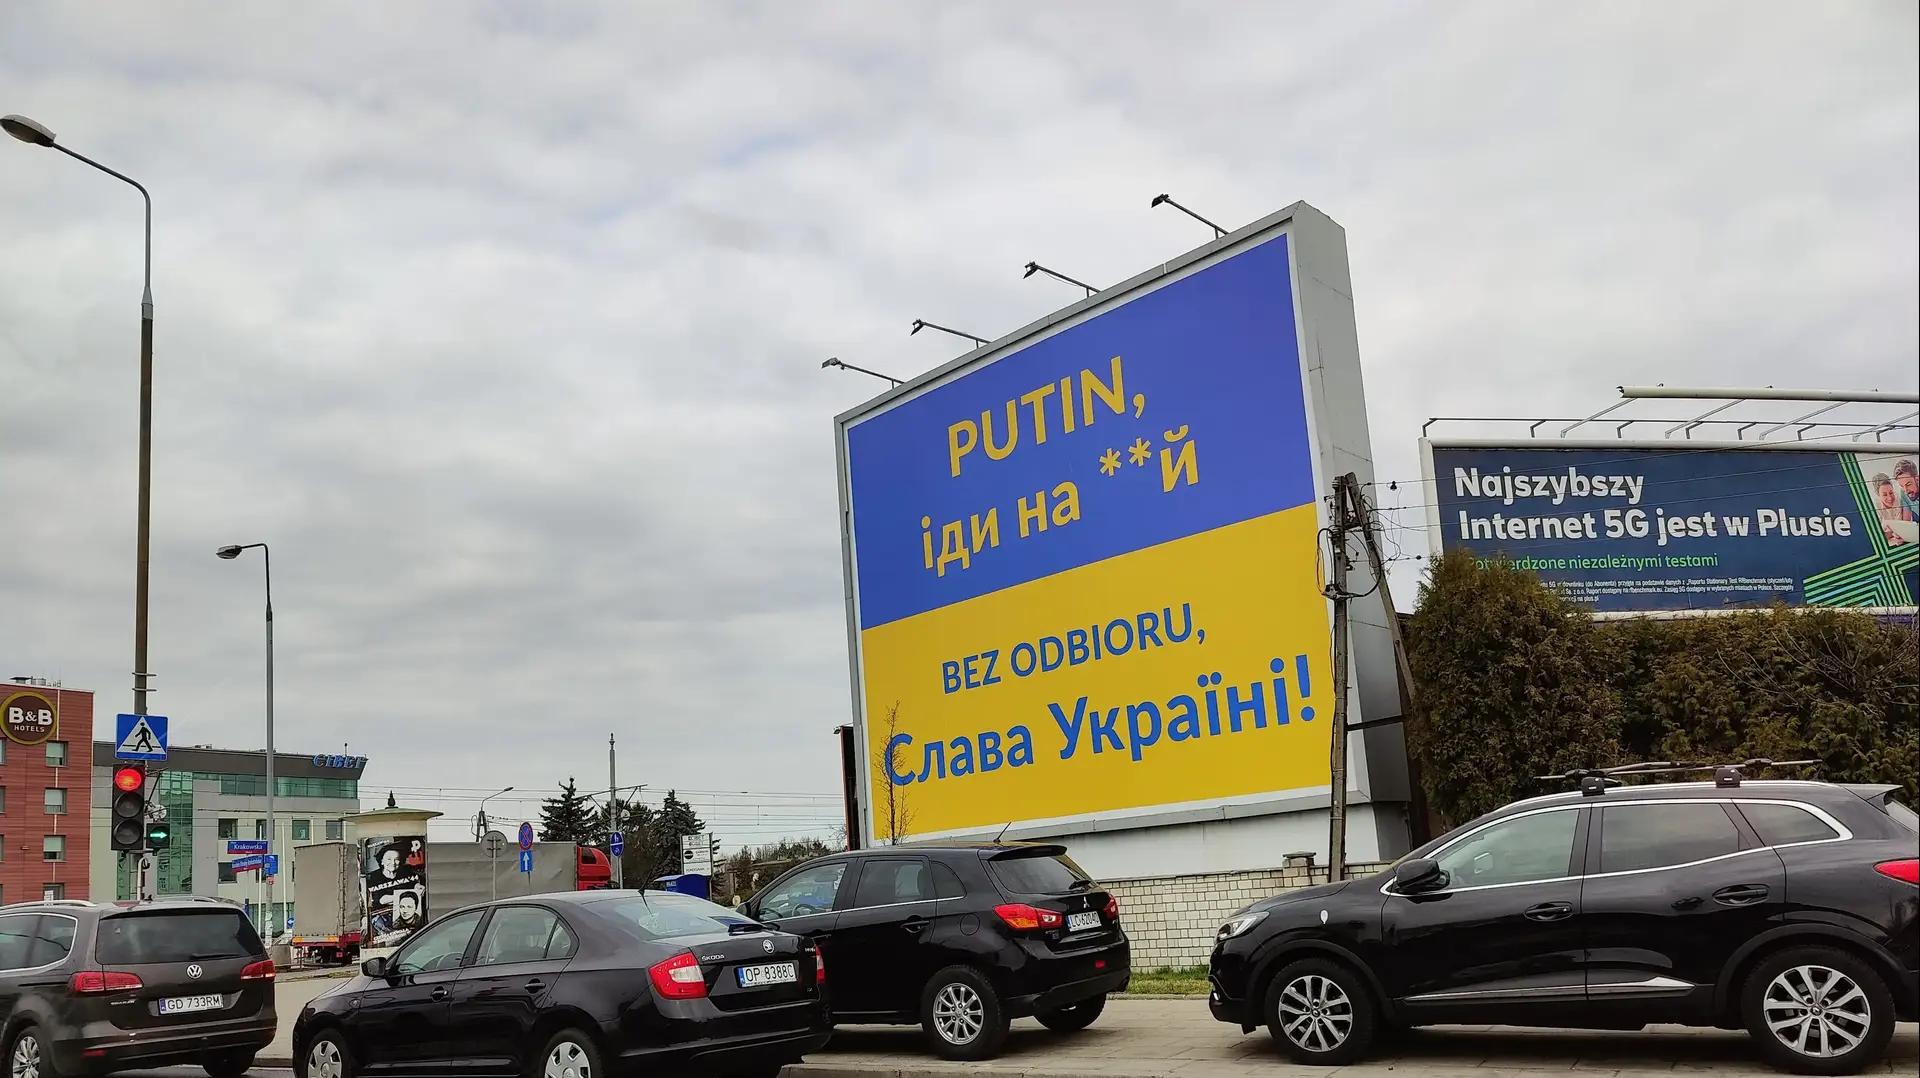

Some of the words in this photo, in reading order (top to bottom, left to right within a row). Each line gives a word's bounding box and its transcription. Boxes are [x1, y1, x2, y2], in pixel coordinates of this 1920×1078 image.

[947, 356, 1145, 477] PUTIN,
[1454, 465, 1644, 505] Najszybszy
[921, 515, 999, 577] іди
[1017, 481, 1080, 538] на
[1459, 510, 1598, 540] Internet
[1604, 508, 1649, 538] 5G
[1656, 507, 1718, 546] jest
[1722, 516, 1750, 537] w
[1756, 507, 1852, 537] Plusie
[1569, 554, 1663, 572] niezależnymi
[1665, 553, 1719, 568] testami
[942, 650, 1001, 694] BEZ
[1011, 603, 1205, 677] ODBIORU,
[9, 707, 52, 725] B&B
[884, 724, 1034, 786] Слава
[1048, 655, 1315, 761] Україні!
[745, 967, 761, 982] OP
[167, 999, 184, 1010] GD
[187, 995, 220, 1008] 733RM
